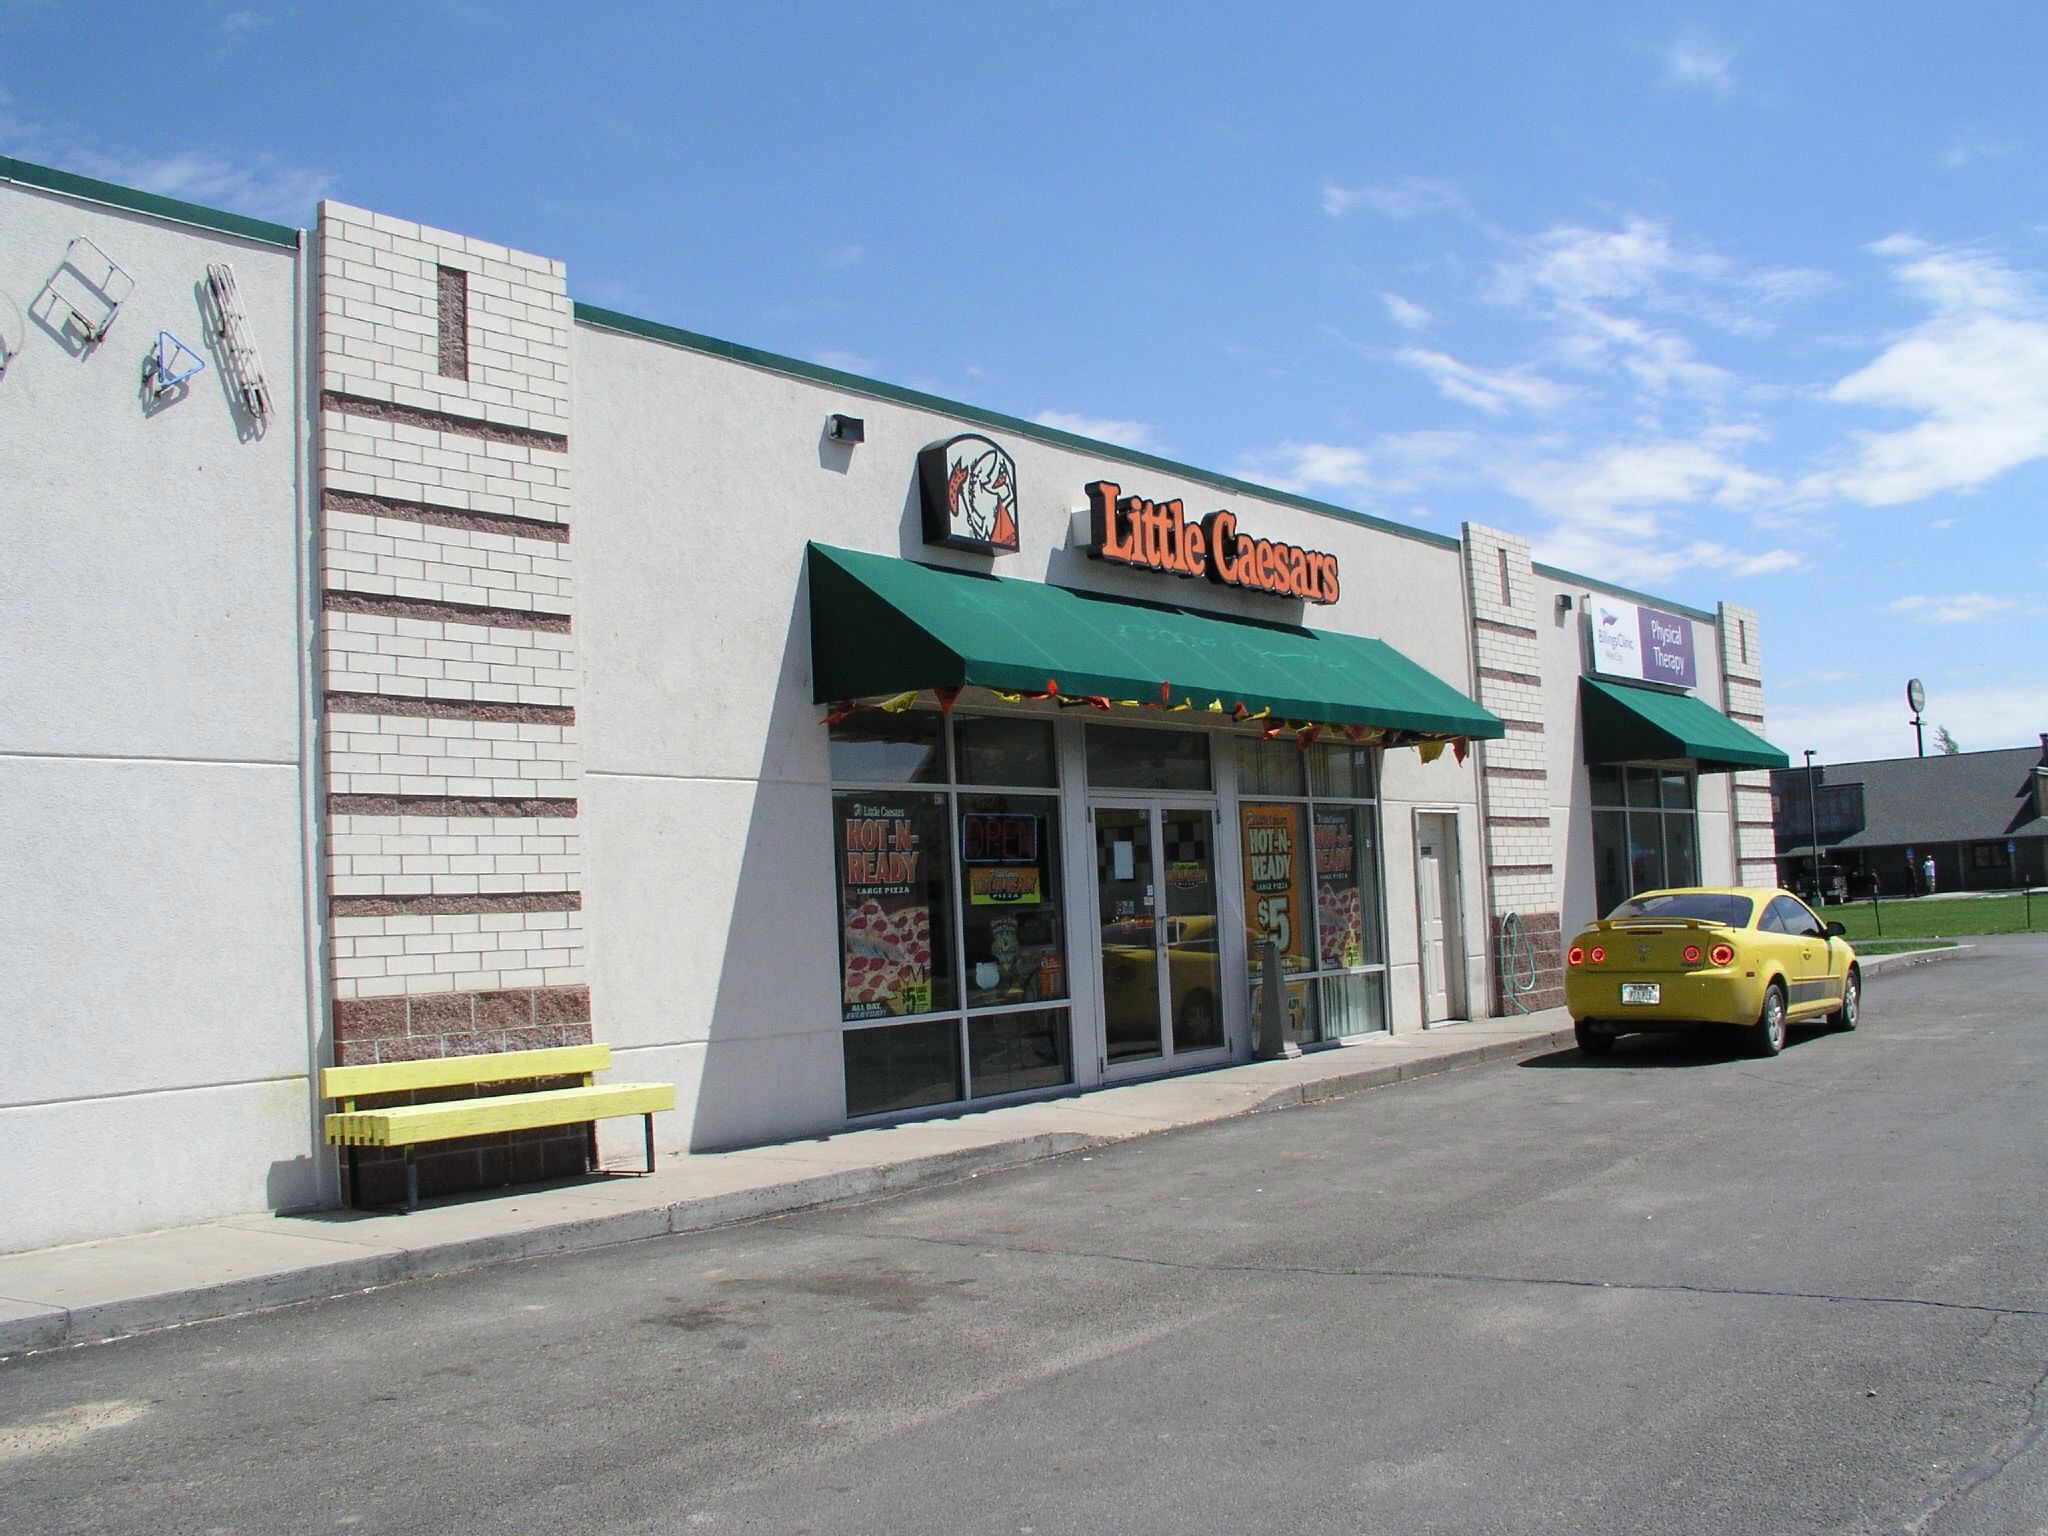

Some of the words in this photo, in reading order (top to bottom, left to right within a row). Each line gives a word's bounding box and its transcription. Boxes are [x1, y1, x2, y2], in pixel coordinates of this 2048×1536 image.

[1100, 480, 1205, 577] Little
[1212, 510, 1340, 602] Caesars
[1651, 619, 1682, 647] Physical
[1652, 646, 1685, 676] Therapy
[863, 806, 880, 817] Little
[967, 816, 1034, 858] OPEN
[847, 851, 919, 884] READY
[1251, 854, 1292, 881] READY
[857, 887, 883, 895] LARGE
[884, 886, 910, 894] PIZZA
[851, 1003, 865, 1012] ALL
